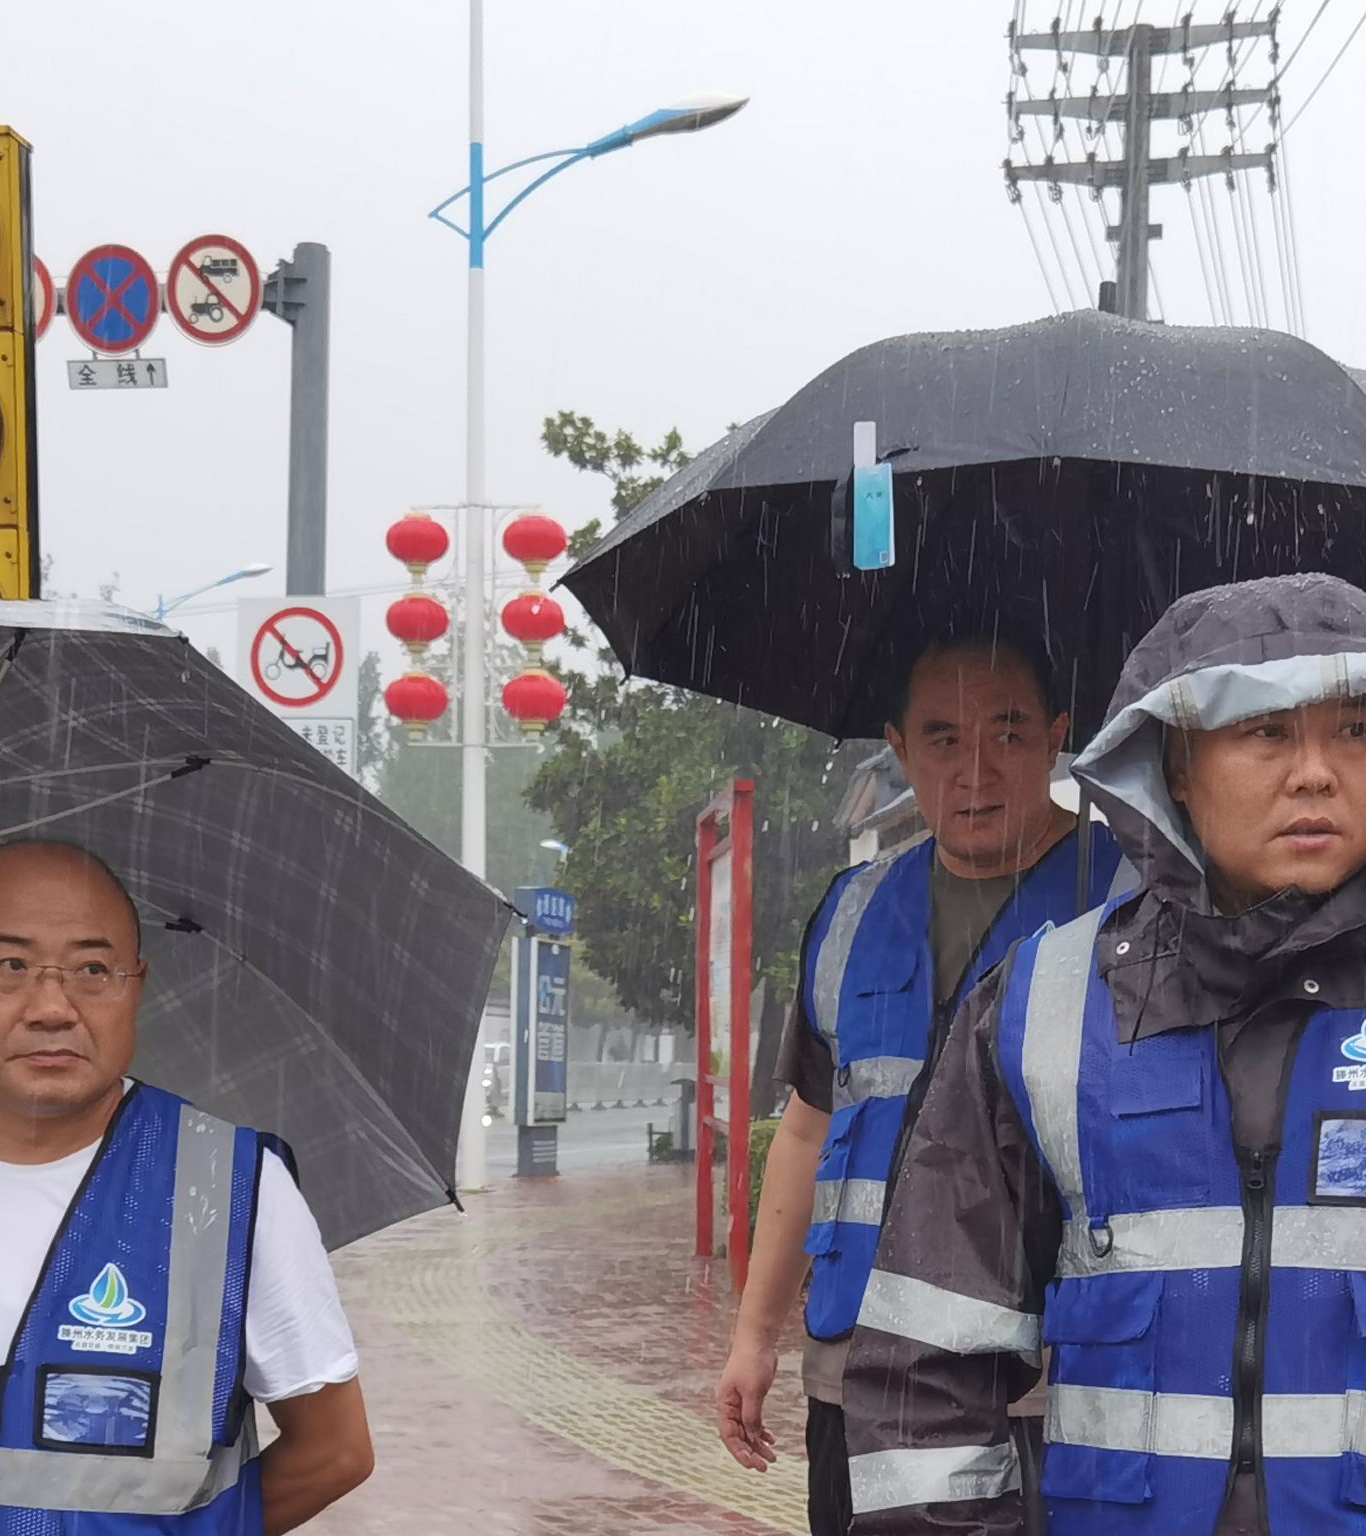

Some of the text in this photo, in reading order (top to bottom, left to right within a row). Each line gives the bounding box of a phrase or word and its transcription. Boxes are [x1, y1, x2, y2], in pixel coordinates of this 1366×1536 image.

[77, 363, 138, 387] 全线
[61, 1327, 149, 1345] 滕州水务发展集团
